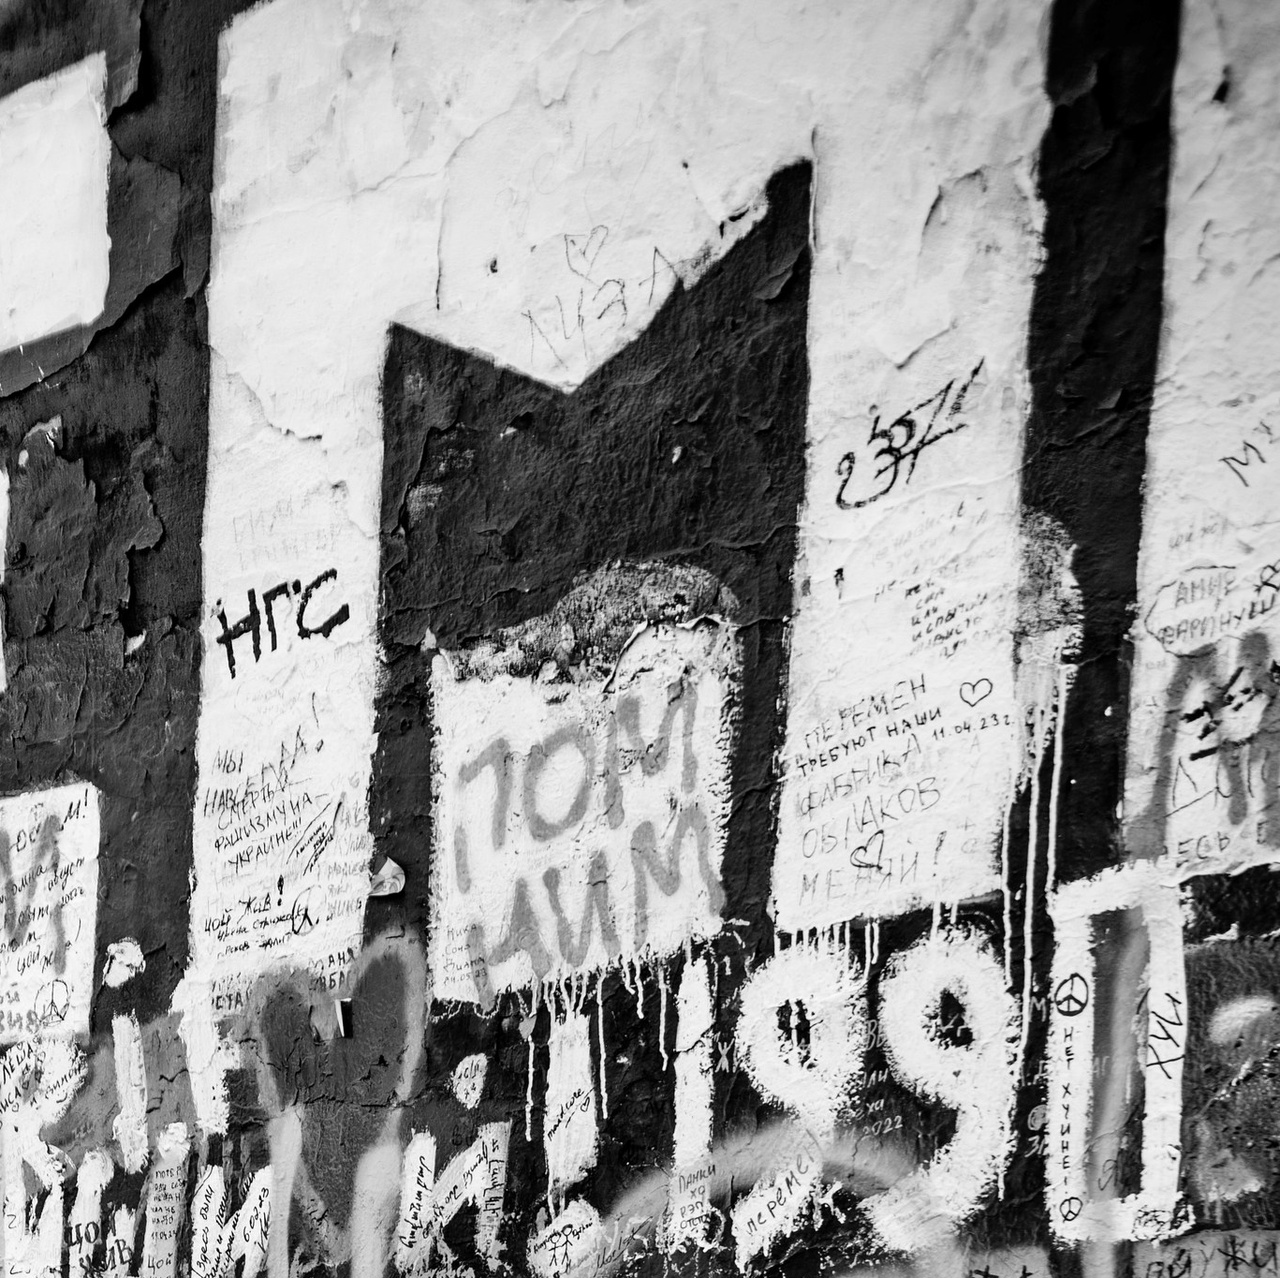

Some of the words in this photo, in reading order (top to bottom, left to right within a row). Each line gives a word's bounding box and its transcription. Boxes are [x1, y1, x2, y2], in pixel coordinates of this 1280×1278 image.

[217, 568, 350, 679] НГС
[804, 673, 927, 752] ПЕРЕМЕН
[886, 705, 942, 739] НАШИ
